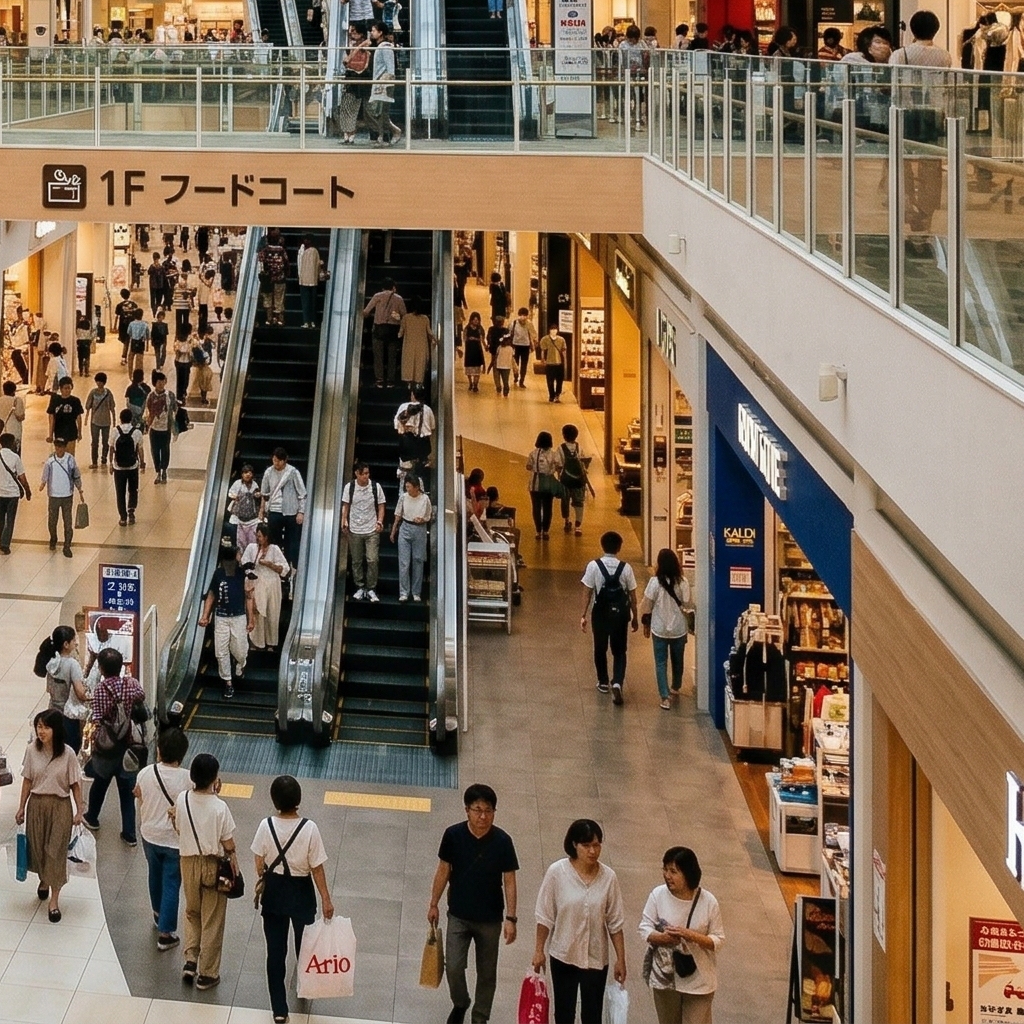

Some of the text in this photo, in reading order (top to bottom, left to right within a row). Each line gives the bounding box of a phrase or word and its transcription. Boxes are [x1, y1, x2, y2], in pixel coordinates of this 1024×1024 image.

[100, 170, 355, 209] 1F フードコート
[724, 527, 756, 539] KALDI
[304, 954, 351, 974] Ario
